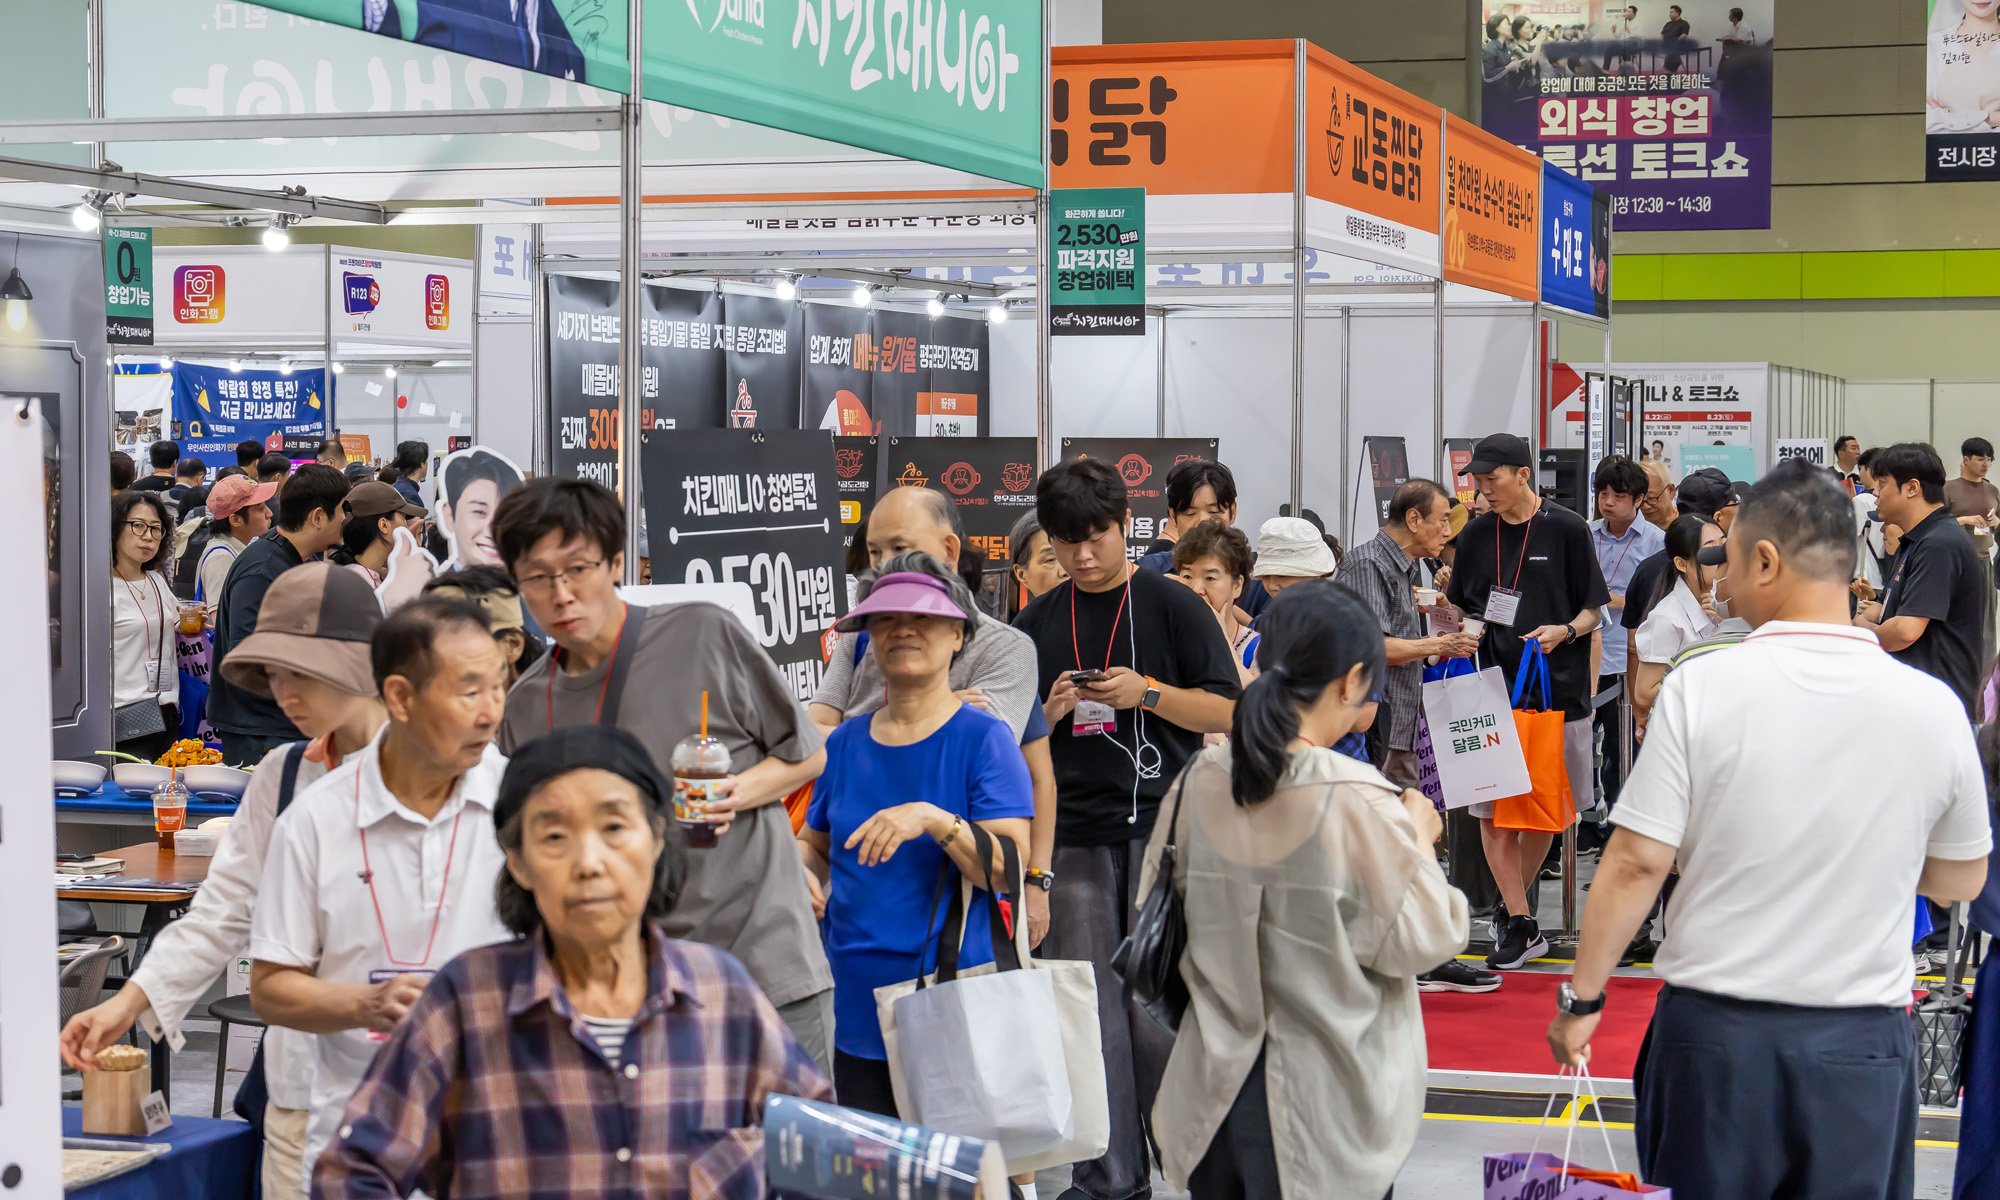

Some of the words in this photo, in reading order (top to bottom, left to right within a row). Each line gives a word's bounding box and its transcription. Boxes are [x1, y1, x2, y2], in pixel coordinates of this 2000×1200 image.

[791, 0, 1019, 112] 치킨매니아
[1541, 77, 1571, 93] 창업에
[1574, 76, 1595, 92] 대해
[1598, 75, 1626, 91] 궁금한
[1628, 75, 1646, 91] 모든
[1650, 75, 1668, 90] 것을
[1670, 74, 1711, 90] 해결하는
[1540, 98, 1617, 136] 외식
[1630, 96, 1708, 135] 창업
[1352, 98, 1423, 204] 교동찜닭
[1515, 144, 1617, 181] 루션
[1631, 141, 1749, 180] 토크쇼
[1938, 145, 1997, 169] 전시장
[1448, 155, 1456, 206] 월
[1458, 160, 1482, 216] 천만원
[1484, 172, 1505, 225] 순수익
[1507, 182, 1534, 234] 쉽습니다
[1632, 196, 1664, 213] 12:30
[1678, 196, 1711, 213] 14:30
[1065, 209, 1096, 219] 화끈하게
[1551, 217, 1583, 278] 우대포
[1057, 249, 1134, 270] 파격지원
[1058, 271, 1134, 291] 창업혜택
[108, 285, 150, 306] 창업가능
[351, 287, 367, 300] R123
[180, 308, 218, 320] 인화그램
[1073, 315, 1140, 328] 치킨매니아
[557, 311, 588, 341] 세가지
[650, 319, 688, 349] 동일기물!
[690, 322, 711, 350] 동일
[737, 326, 757, 353] 동일
[757, 328, 787, 355] 조리법!
[810, 335, 830, 364] 업계
[831, 337, 852, 365] 최저
[853, 333, 879, 371] 메뉴
[881, 335, 917, 373] 원가율
[950, 346, 979, 372] 전격공개
[218, 379, 249, 399] 박람회
[252, 380, 272, 399] 한정
[274, 380, 299, 400] 특전!
[581, 363, 621, 397] 매몰비
[641, 366, 659, 398] 원!
[1672, 386, 1684, 402] &
[1689, 385, 1740, 402] 토크쇼
[220, 401, 240, 419] 지금
[244, 401, 296, 420] 만나보세요!
[561, 416, 587, 450] 진짜
[187, 443, 227, 452] 무인사진인화기
[227, 444, 237, 452] 인화
[284, 441, 298, 449] 사진
[682, 473, 766, 516] 치킨매니아
[767, 473, 818, 513] 창업특전
[1449, 713, 1496, 733] 국민커피
